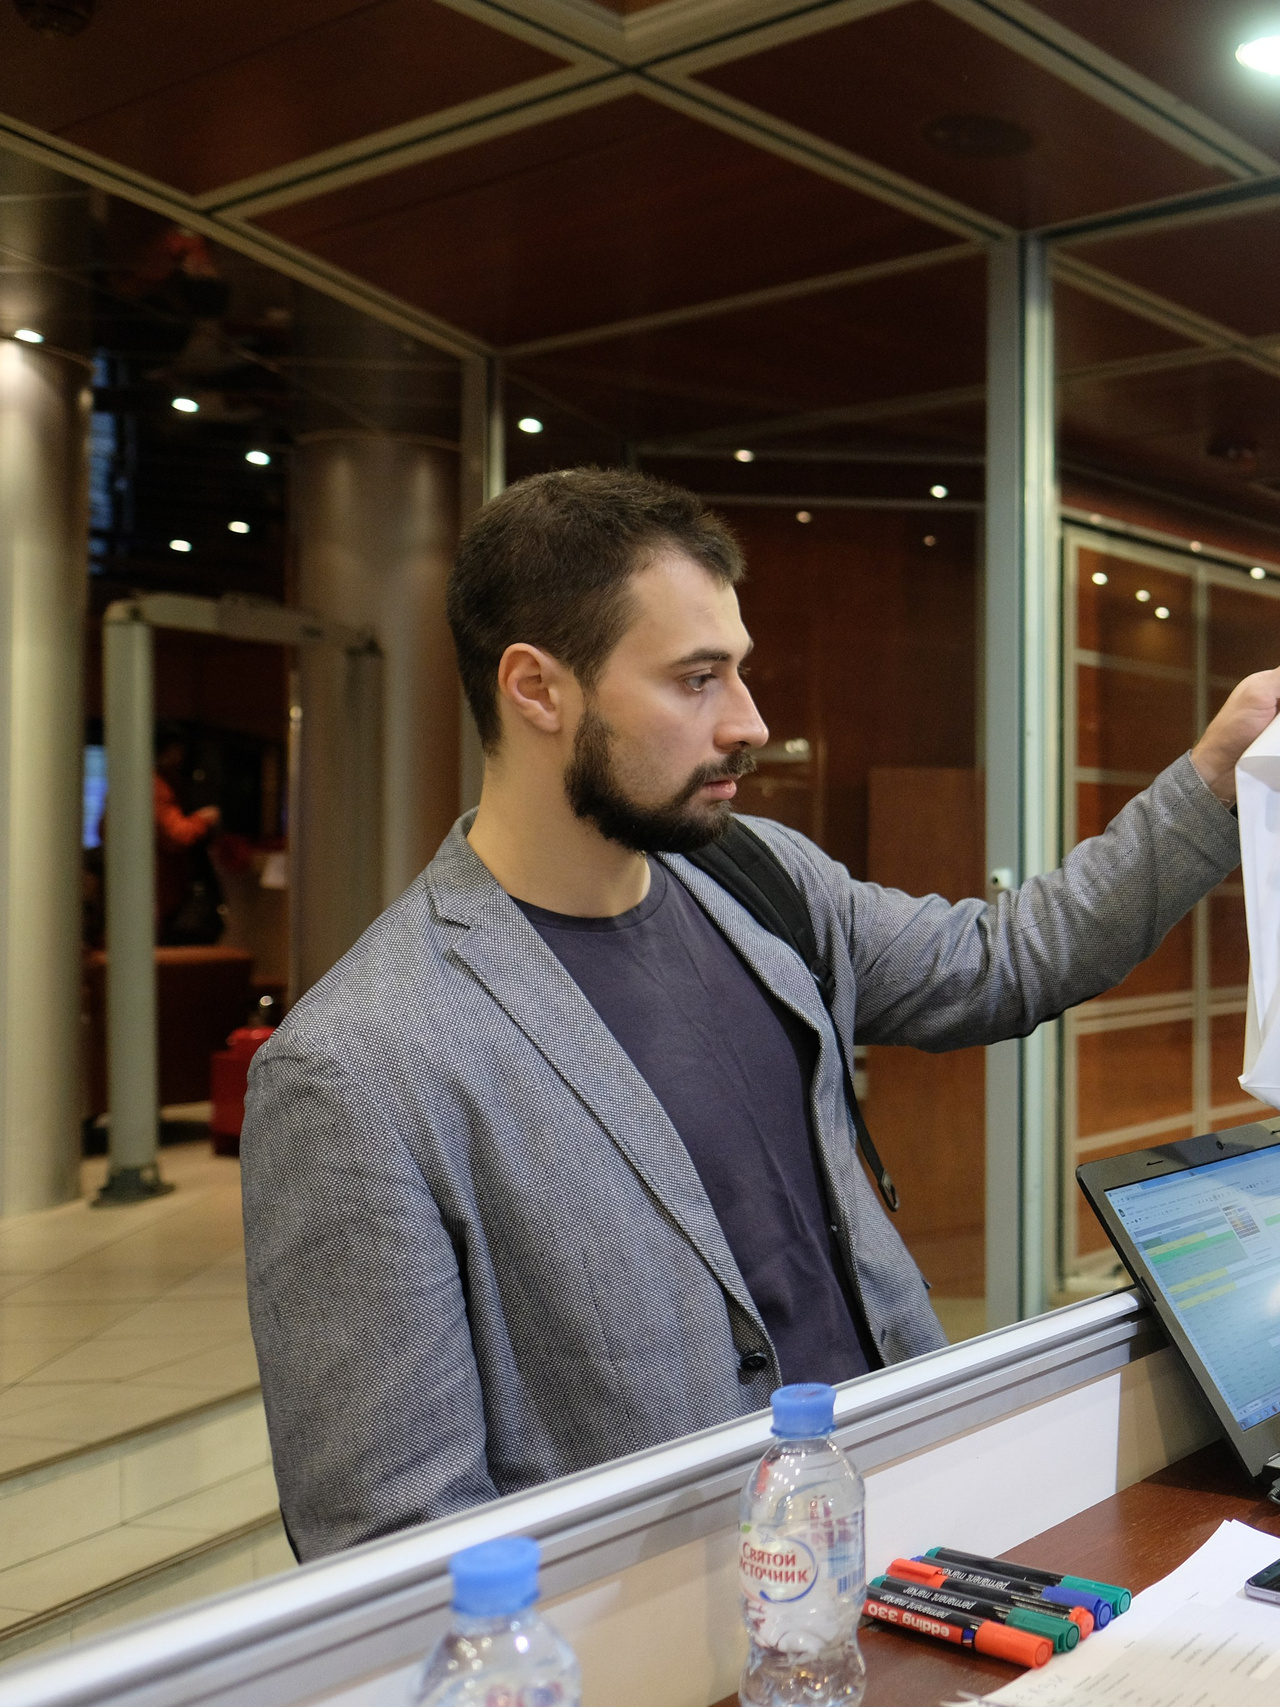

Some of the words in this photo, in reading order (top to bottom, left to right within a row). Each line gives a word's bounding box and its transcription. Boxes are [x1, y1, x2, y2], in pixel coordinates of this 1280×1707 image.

[941, 1567, 968, 1580] marke
[966, 1573, 1011, 1591] permanent
[880, 1593, 910, 1607] marker
[903, 1586, 933, 1599] marker
[931, 1592, 977, 1610] permanent
[867, 1603, 899, 1623] 330
[906, 1601, 952, 1619] permanent
[902, 1611, 950, 1638] edding
